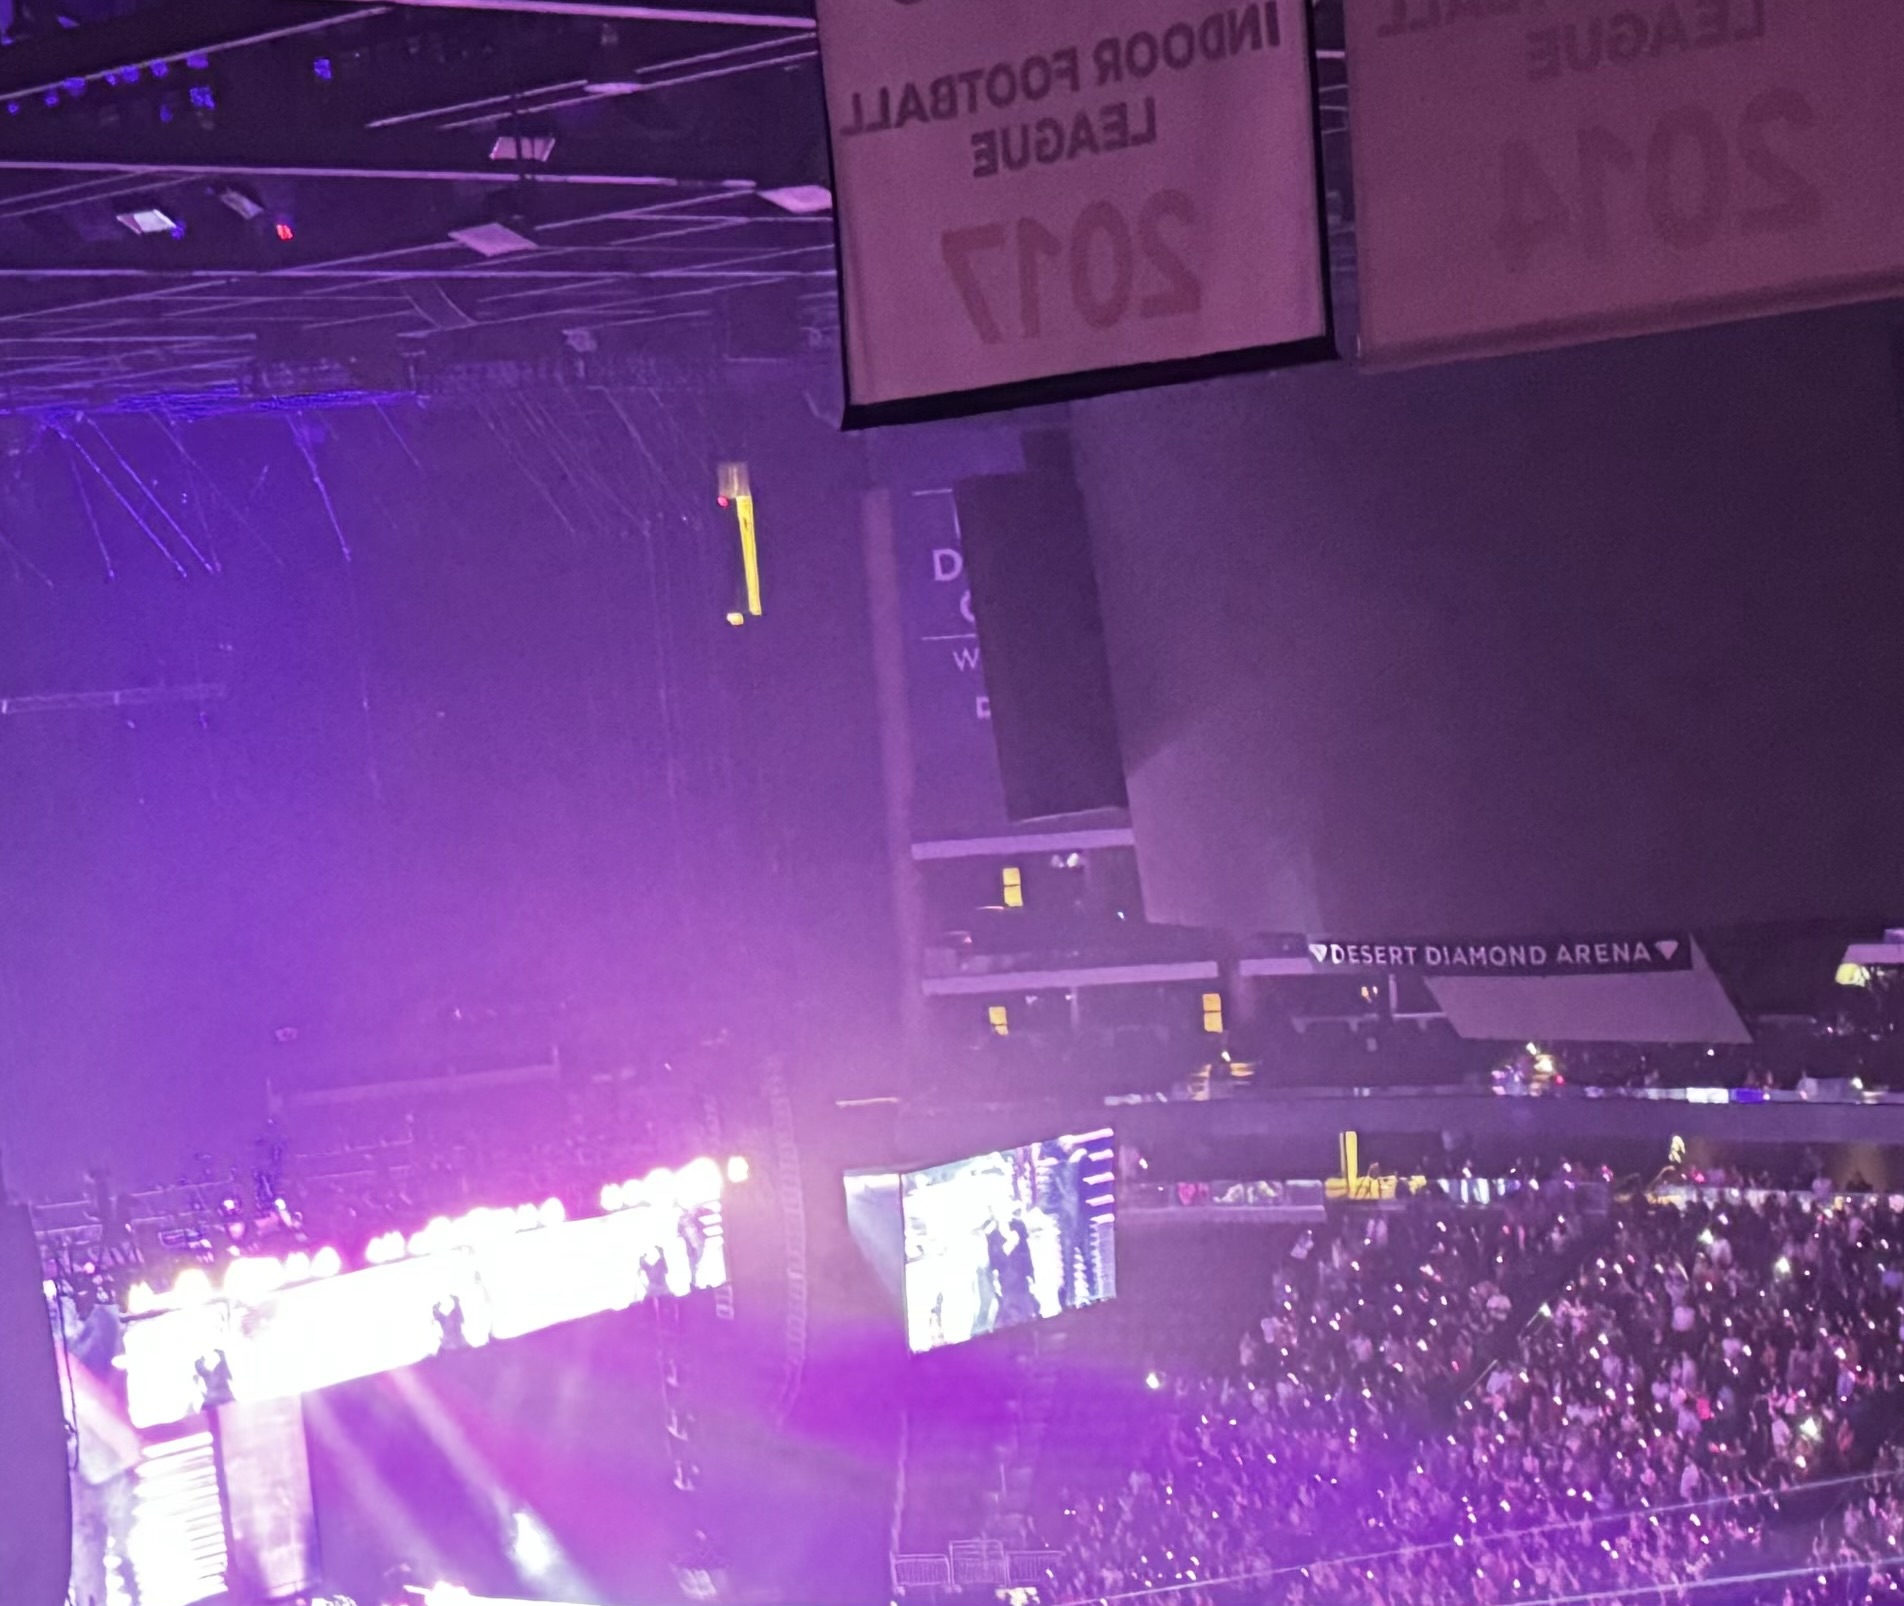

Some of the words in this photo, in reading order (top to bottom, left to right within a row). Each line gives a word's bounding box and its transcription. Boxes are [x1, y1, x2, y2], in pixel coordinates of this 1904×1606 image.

[1331, 943, 1417, 966] DESERT
[1424, 943, 1547, 967] DIAMOND
[1555, 941, 1652, 964] ARENA
